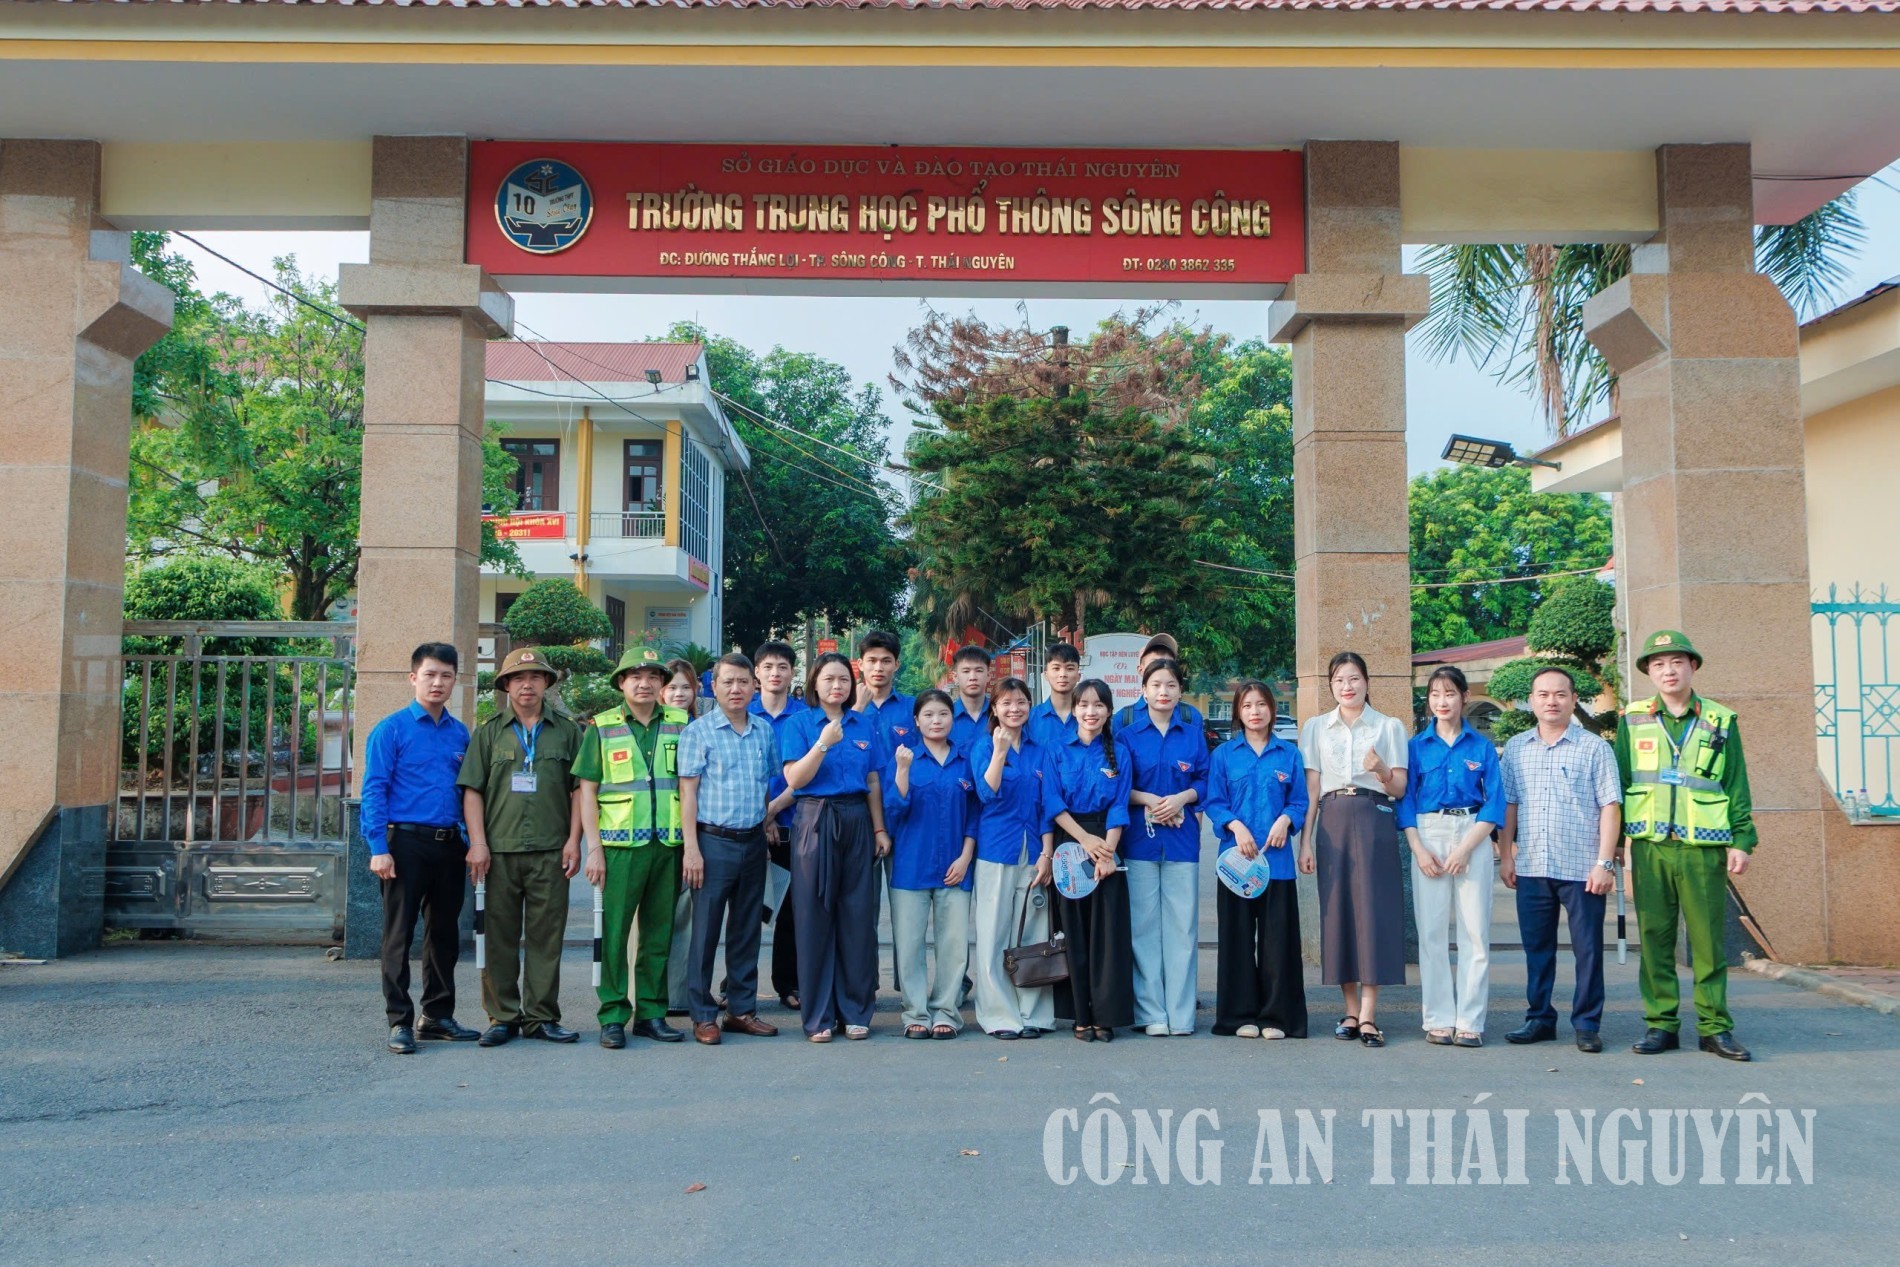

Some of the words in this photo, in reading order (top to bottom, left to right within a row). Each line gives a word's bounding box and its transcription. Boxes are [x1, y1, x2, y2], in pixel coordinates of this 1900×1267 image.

[722, 152, 752, 173] SỞ
[758, 153, 816, 174] GIÁO
[823, 159, 869, 178] DỤC
[877, 155, 906, 175] VÀ
[914, 156, 963, 176] ĐÀO
[969, 161, 1016, 180] TẠO
[1022, 157, 1076, 177] THÁI
[1084, 158, 1180, 178] NGUYÊN
[513, 193, 535, 215] 10
[626, 183, 743, 231] TRƯỜNG
[753, 194, 849, 232] TRUNG
[859, 194, 918, 241] HỌC
[927, 179, 987, 234] PHỔ
[996, 187, 1091, 236] THÔNG
[1101, 188, 1182, 236] SÔNG
[1191, 190, 1271, 237] CÔNG
[660, 252, 681, 265] ĐC:
[684, 249, 729, 266] ĐƯỜNG
[732, 247, 776, 266] THẮNG
[779, 253, 798, 269] LỢI
[809, 254, 827, 267] TP.
[831, 251, 865, 267] SÔNG
[870, 252, 906, 268] CÔNG
[916, 255, 927, 268] T.
[931, 253, 960, 269] THÁI
[963, 253, 1014, 269] NGUYÊN
[1122, 257, 1143, 270] ĐT:
[1146, 258, 1177, 271] 0280
[1180, 258, 1210, 271] 3862
[1213, 258, 1235, 271] 335
[1104, 673, 1123, 684] NGÀY
[1124, 675, 1139, 684] MAI
